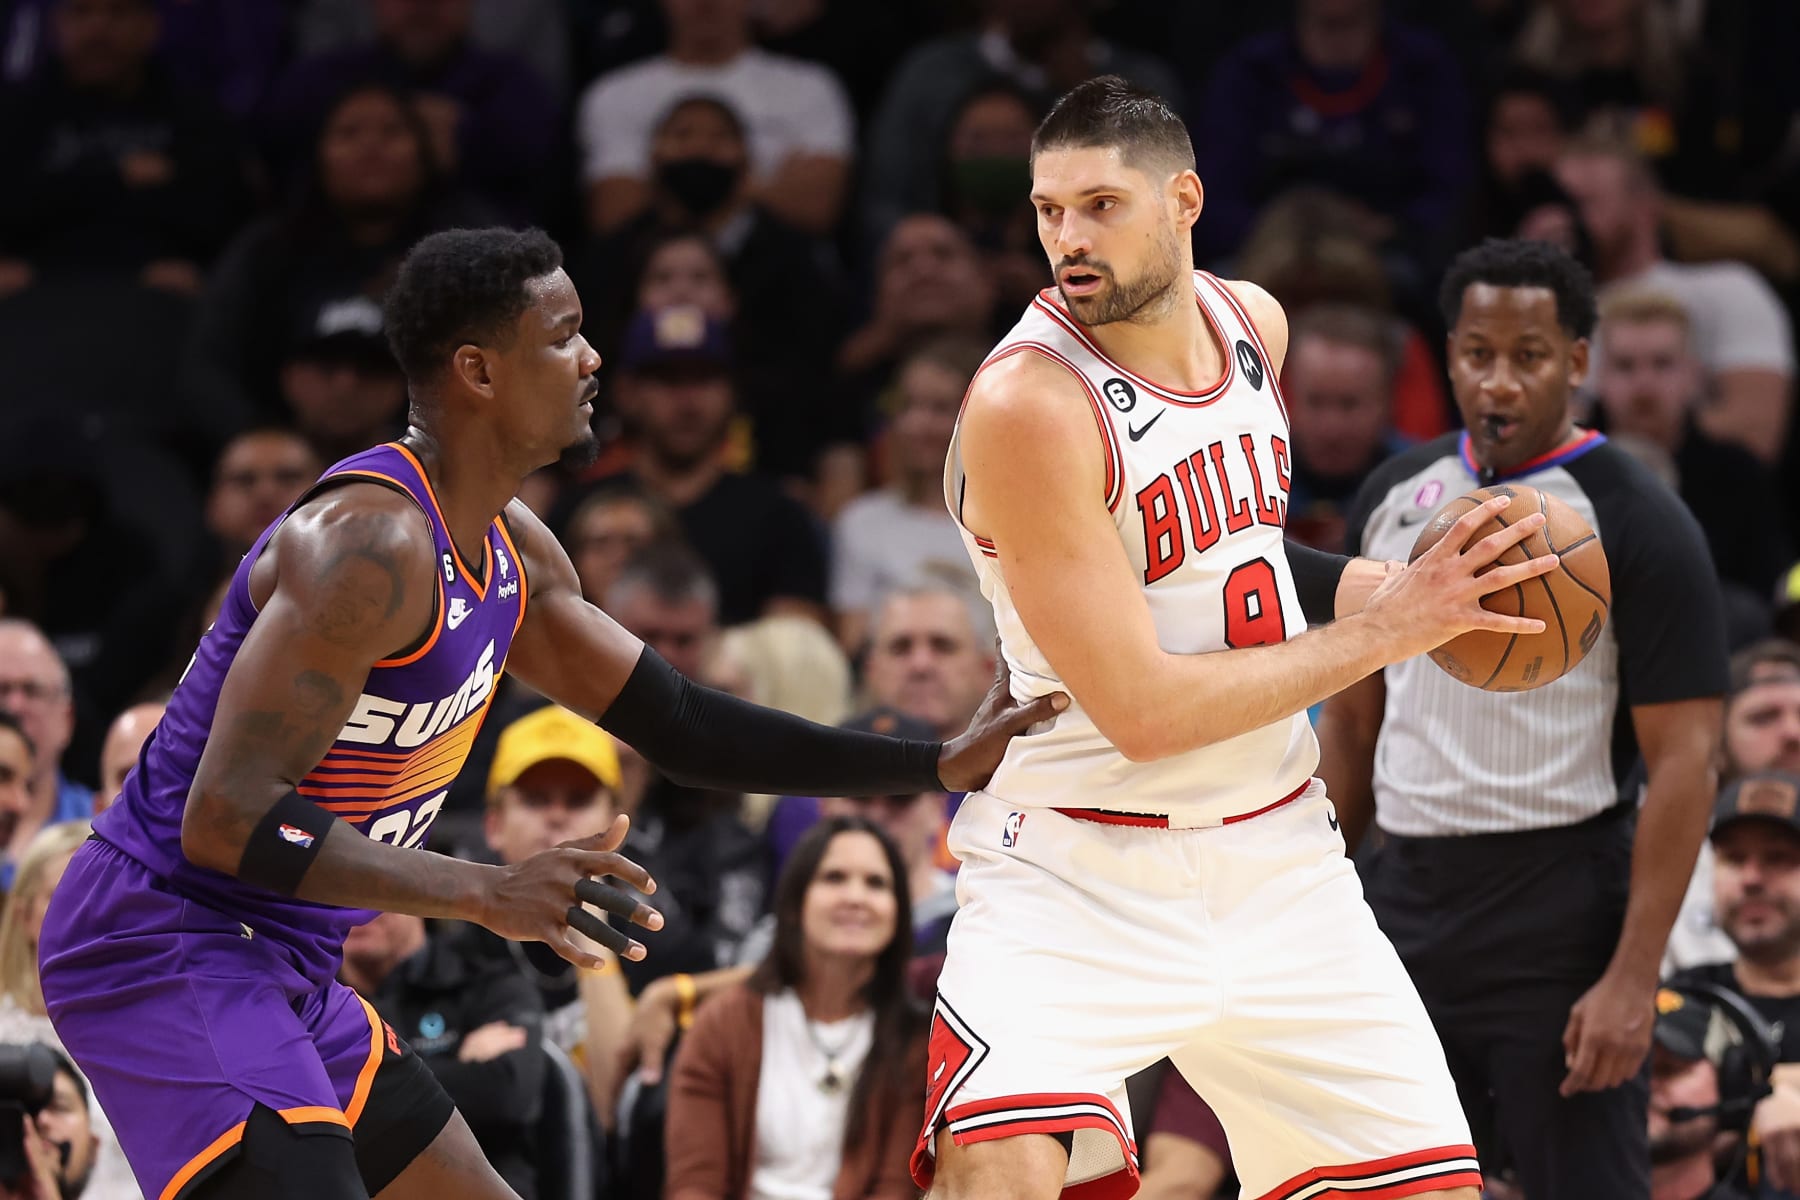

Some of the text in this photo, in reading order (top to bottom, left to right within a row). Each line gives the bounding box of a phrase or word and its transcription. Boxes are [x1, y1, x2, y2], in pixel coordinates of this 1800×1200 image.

[1107, 382, 1132, 411] 6
[1135, 433, 1290, 586] BULLS
[442, 553, 455, 582] 6
[497, 580, 518, 599] PayPal
[1223, 556, 1287, 650] 9
[336, 638, 495, 748] SUNS
